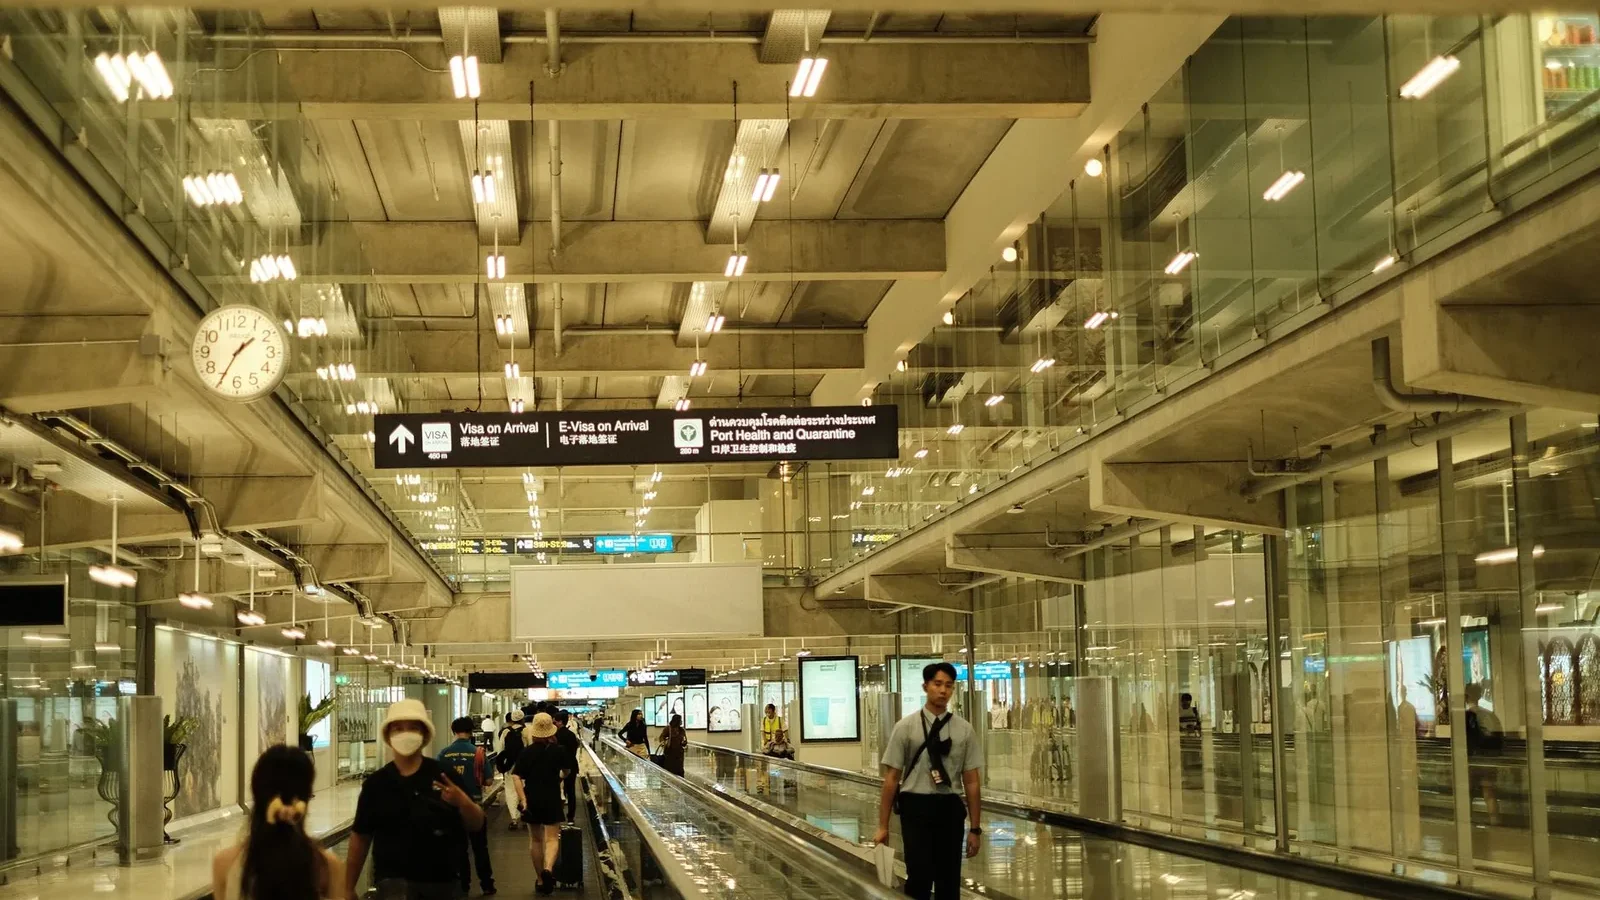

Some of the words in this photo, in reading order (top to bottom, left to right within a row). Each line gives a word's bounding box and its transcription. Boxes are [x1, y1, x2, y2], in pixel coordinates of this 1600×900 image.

[219, 318, 229, 331] 11
[233, 316, 246, 328] 12
[205, 330, 218, 343] 10
[262, 330, 271, 342] 2
[200, 346, 210, 358] 9
[266, 346, 275, 358] 3
[206, 361, 216, 374] 8
[261, 361, 270, 374] 4
[233, 376, 242, 389] 6
[249, 373, 258, 385] 5
[459, 423, 484, 435] Visa
[487, 424, 501, 434] on
[504, 421, 539, 434] Arrival
[559, 421, 595, 432] E-Visa
[597, 422, 611, 432] on
[614, 419, 649, 431] Arrival
[425, 431, 448, 439] VISA
[560, 434, 618, 445] 电子落地签证
[710, 430, 733, 441] Port
[736, 429, 770, 441] Health
[773, 429, 793, 440] and
[796, 428, 856, 440] Quarantine
[460, 436, 500, 447] 落地签证
